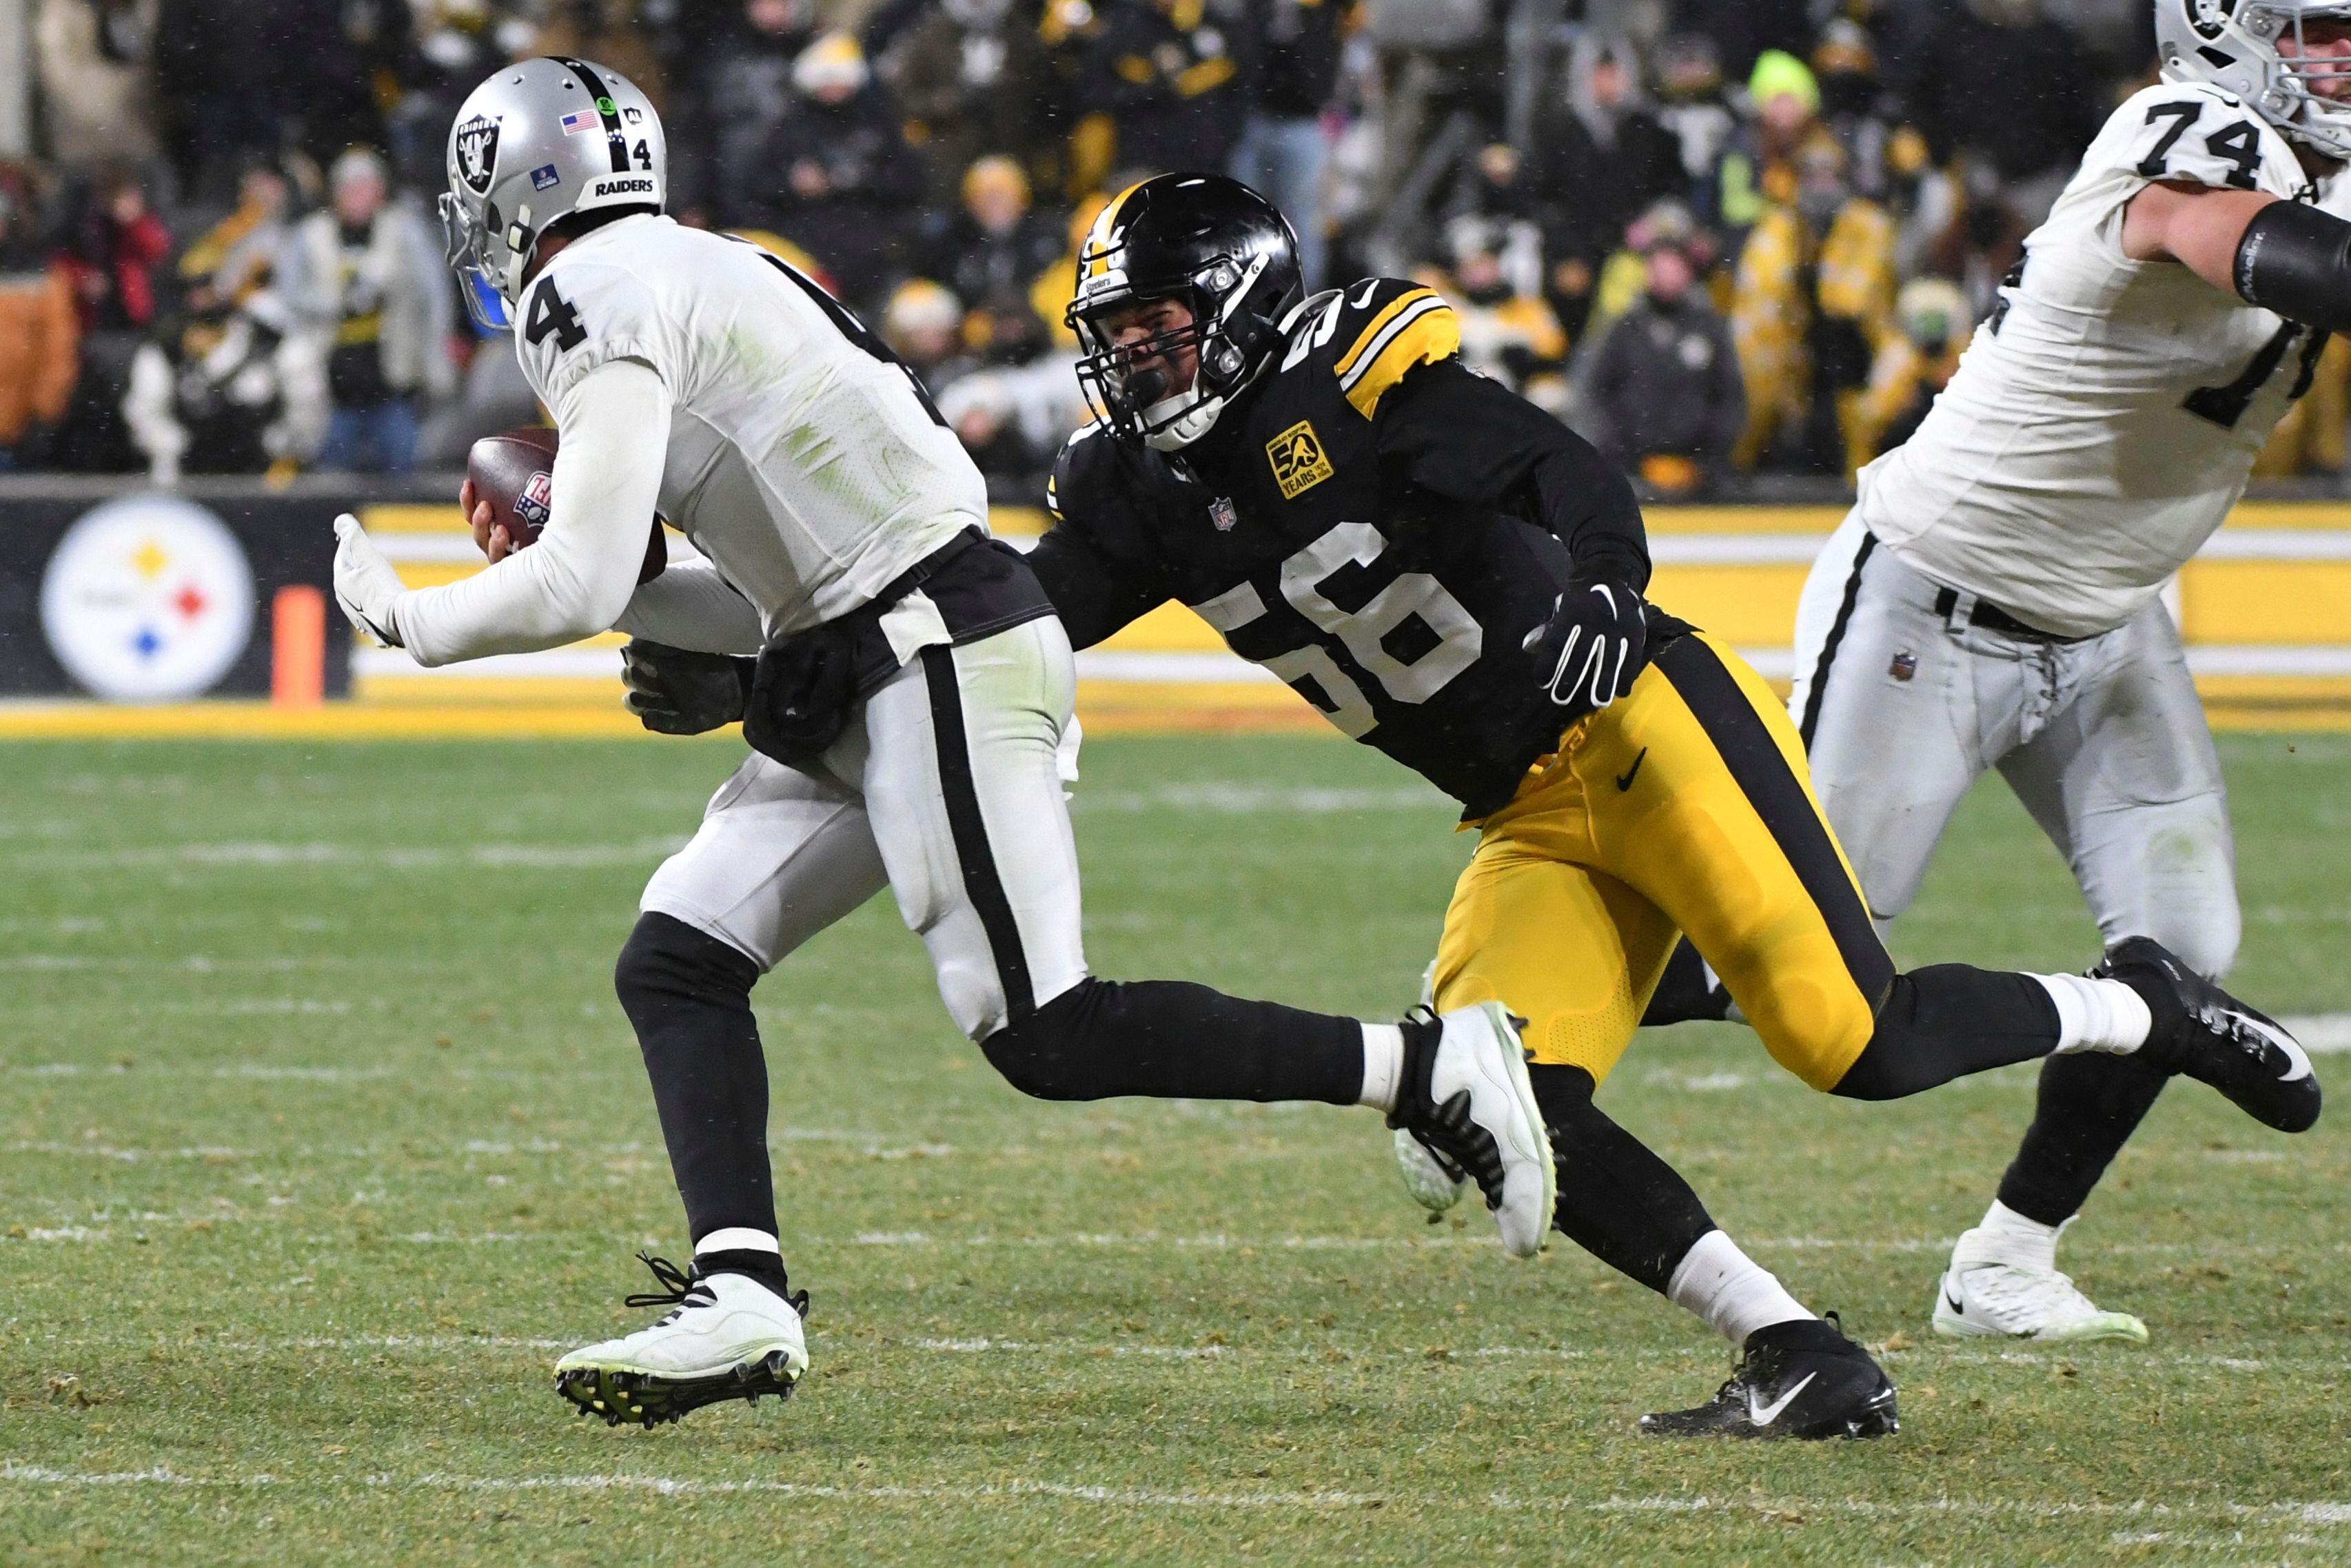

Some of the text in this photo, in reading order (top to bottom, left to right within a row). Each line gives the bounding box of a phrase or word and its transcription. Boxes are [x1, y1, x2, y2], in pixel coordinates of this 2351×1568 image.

[633, 139, 651, 170] 4
[2137, 101, 2262, 191] 74
[595, 180, 653, 196] RAIDERS
[525, 274, 588, 353] 4
[1271, 433, 1319, 481] 50
[1283, 469, 1317, 495] YEARS
[1189, 521, 1483, 740] 56
